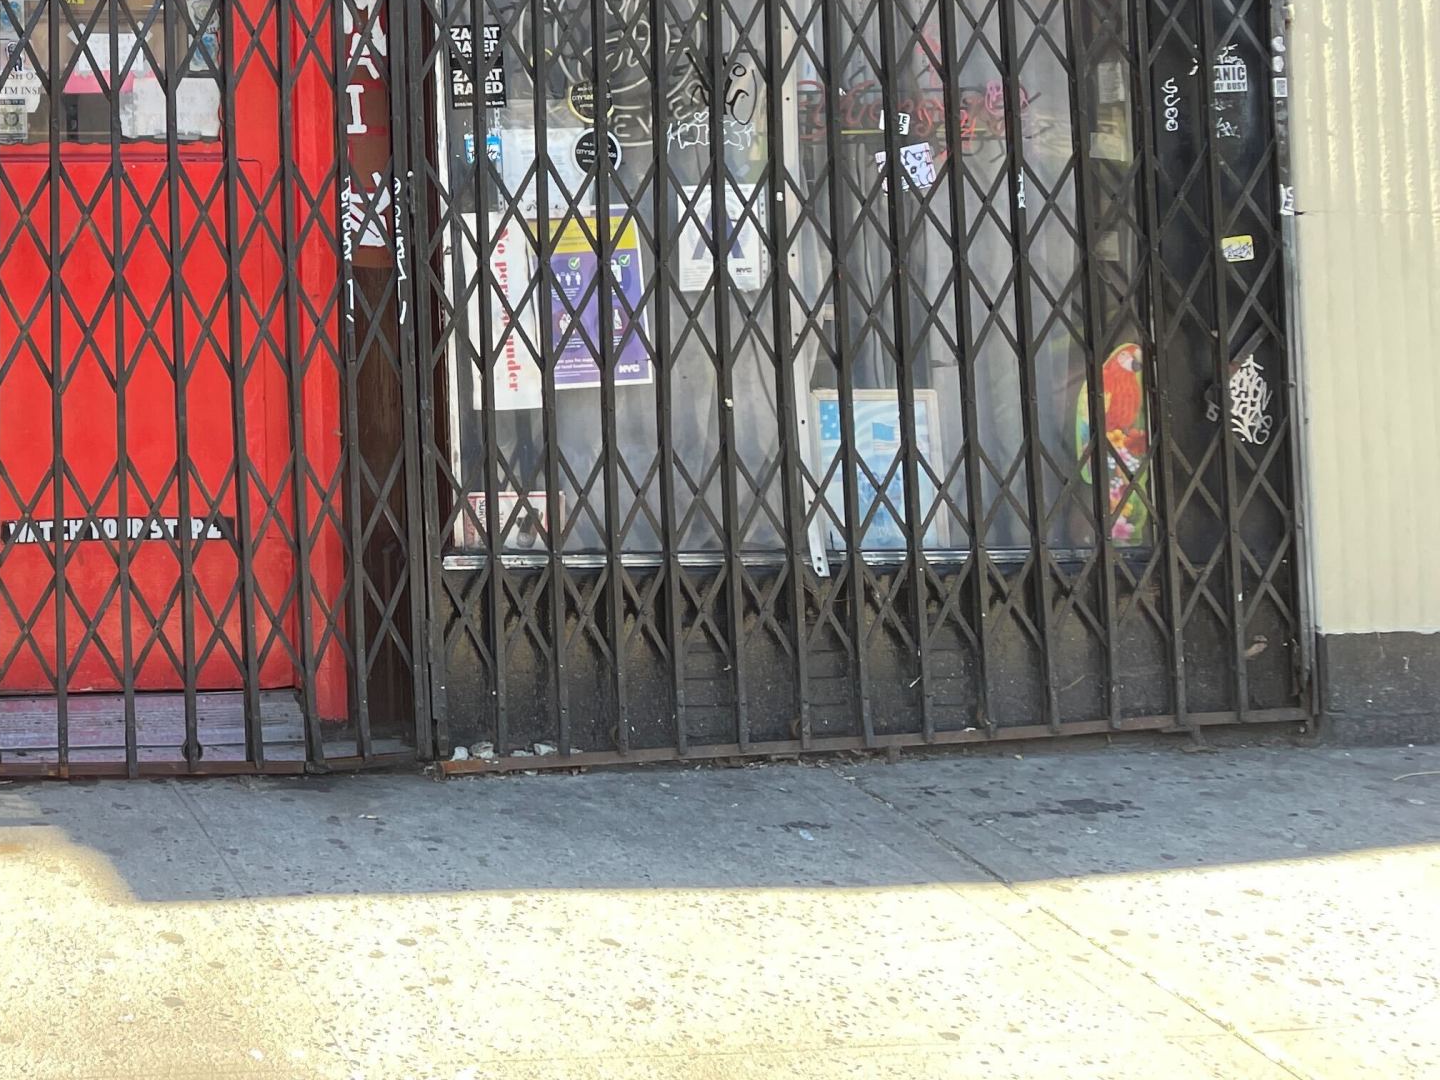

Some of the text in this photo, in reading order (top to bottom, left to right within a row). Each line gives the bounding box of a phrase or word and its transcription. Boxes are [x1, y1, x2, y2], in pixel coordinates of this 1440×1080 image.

[450, 27, 500, 40] ZAAT
[452, 68, 503, 82] ZAAT
[453, 81, 504, 95] RAED
[618, 365, 640, 374] NYC
[8, 520, 84, 543] WATCH
